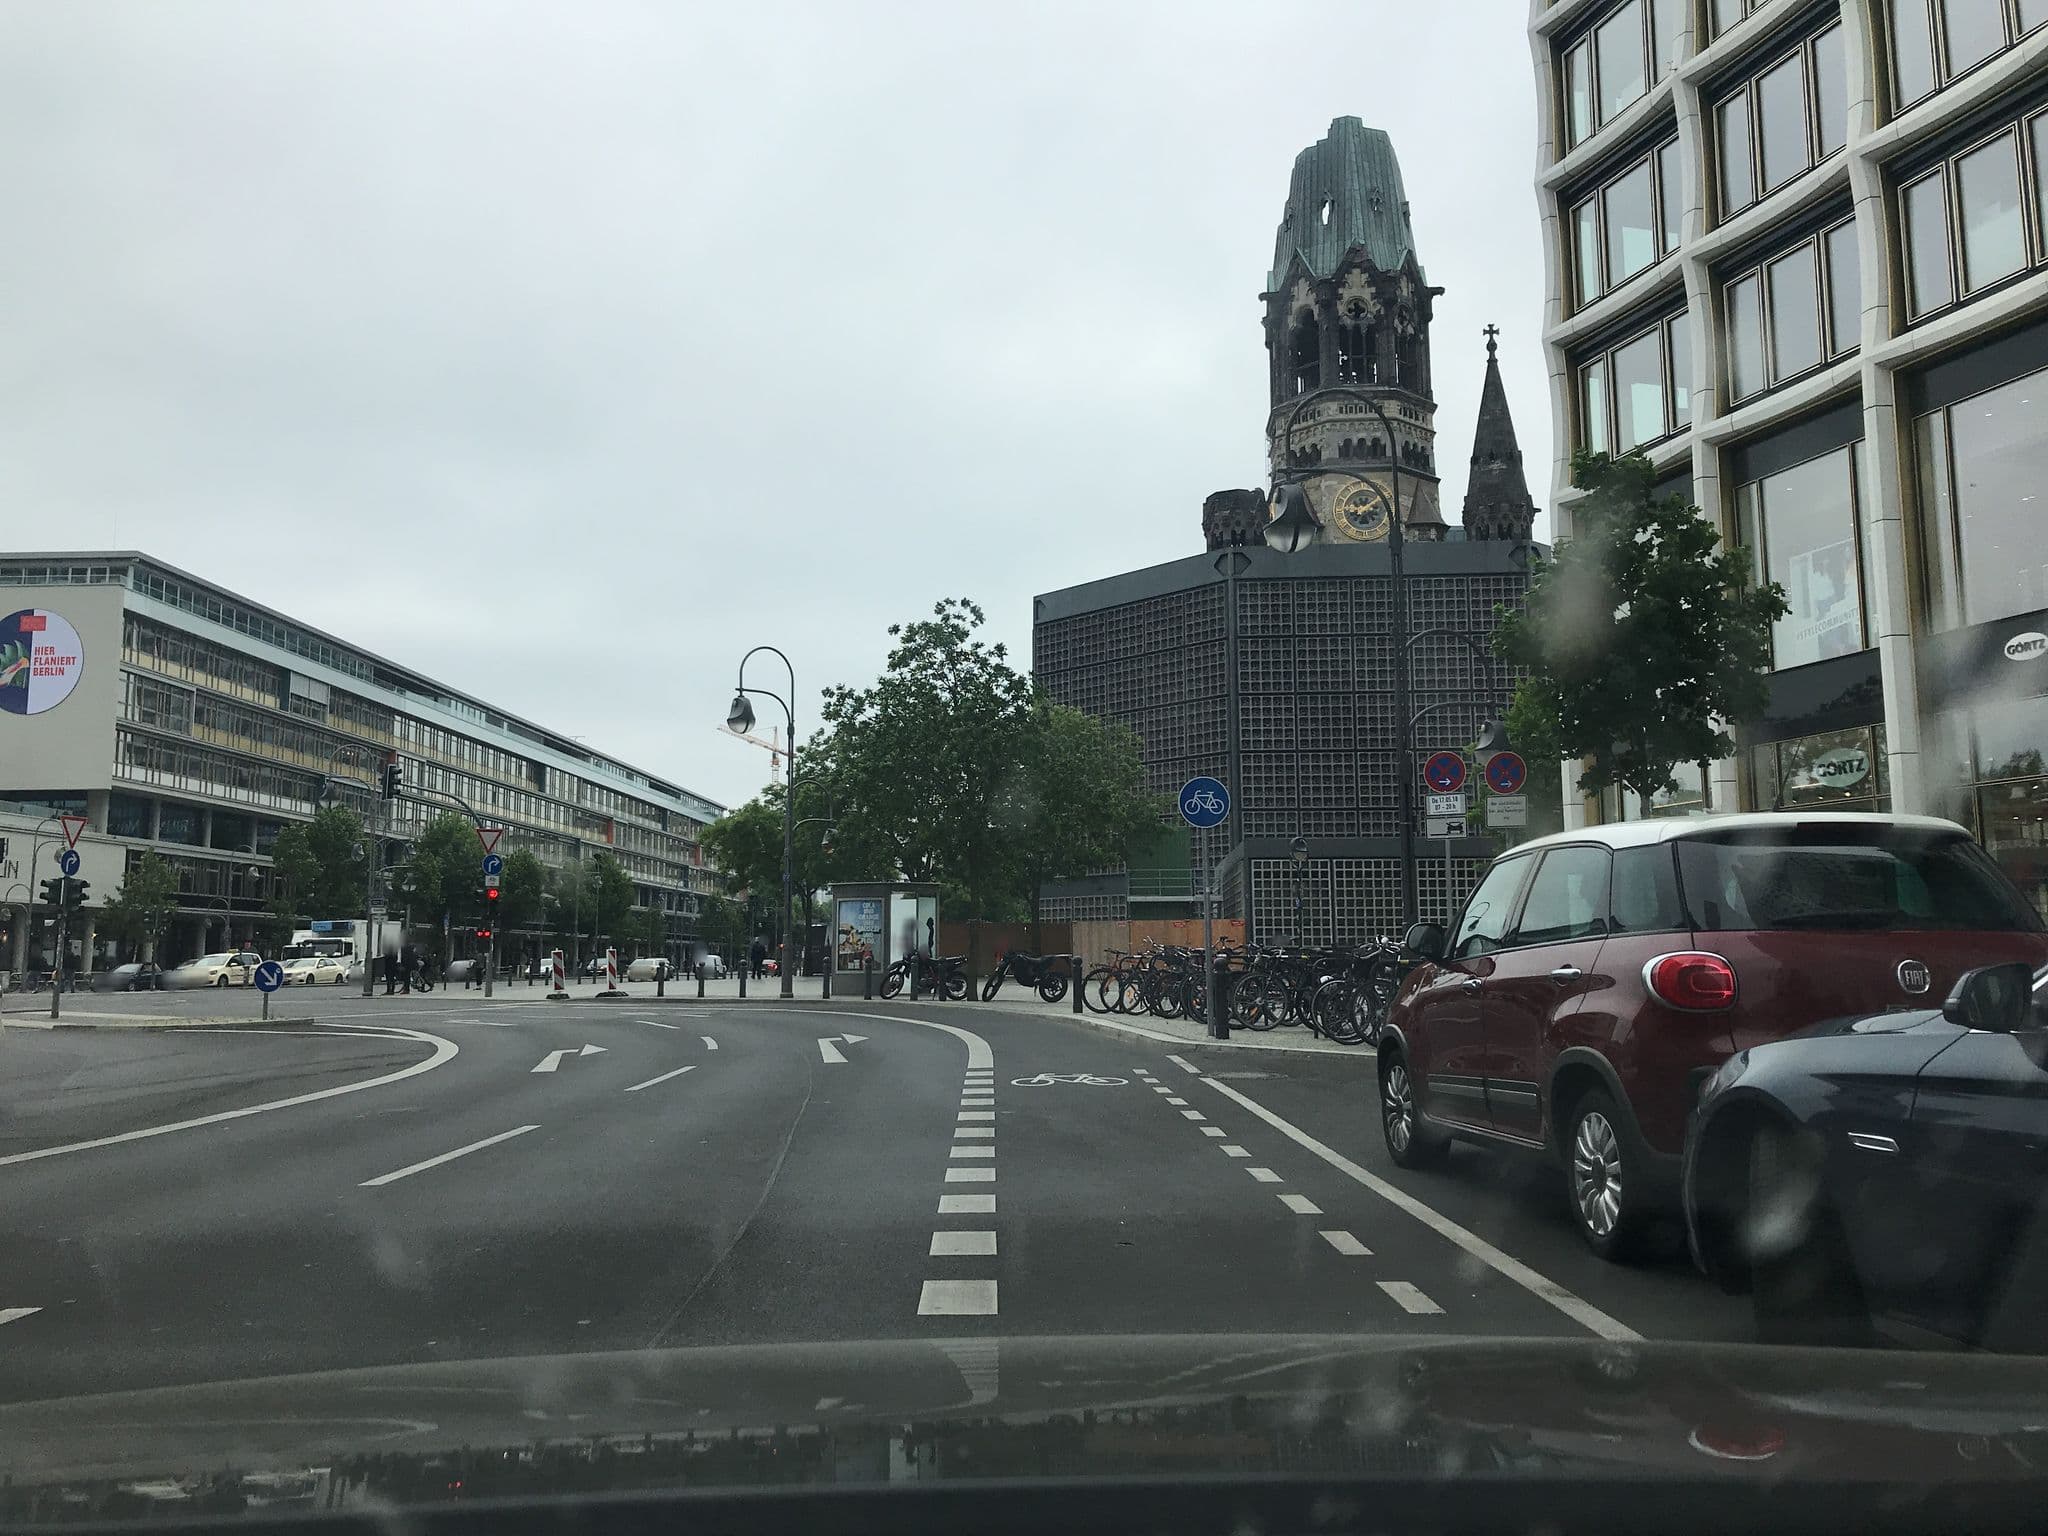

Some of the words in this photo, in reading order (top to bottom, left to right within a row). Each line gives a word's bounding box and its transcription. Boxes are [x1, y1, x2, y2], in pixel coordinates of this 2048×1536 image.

[34, 646, 56, 656] HIER
[33, 656, 77, 666] FLANIERT
[32, 667, 66, 677] BERLIN
[1904, 970, 1925, 985] FIAT
